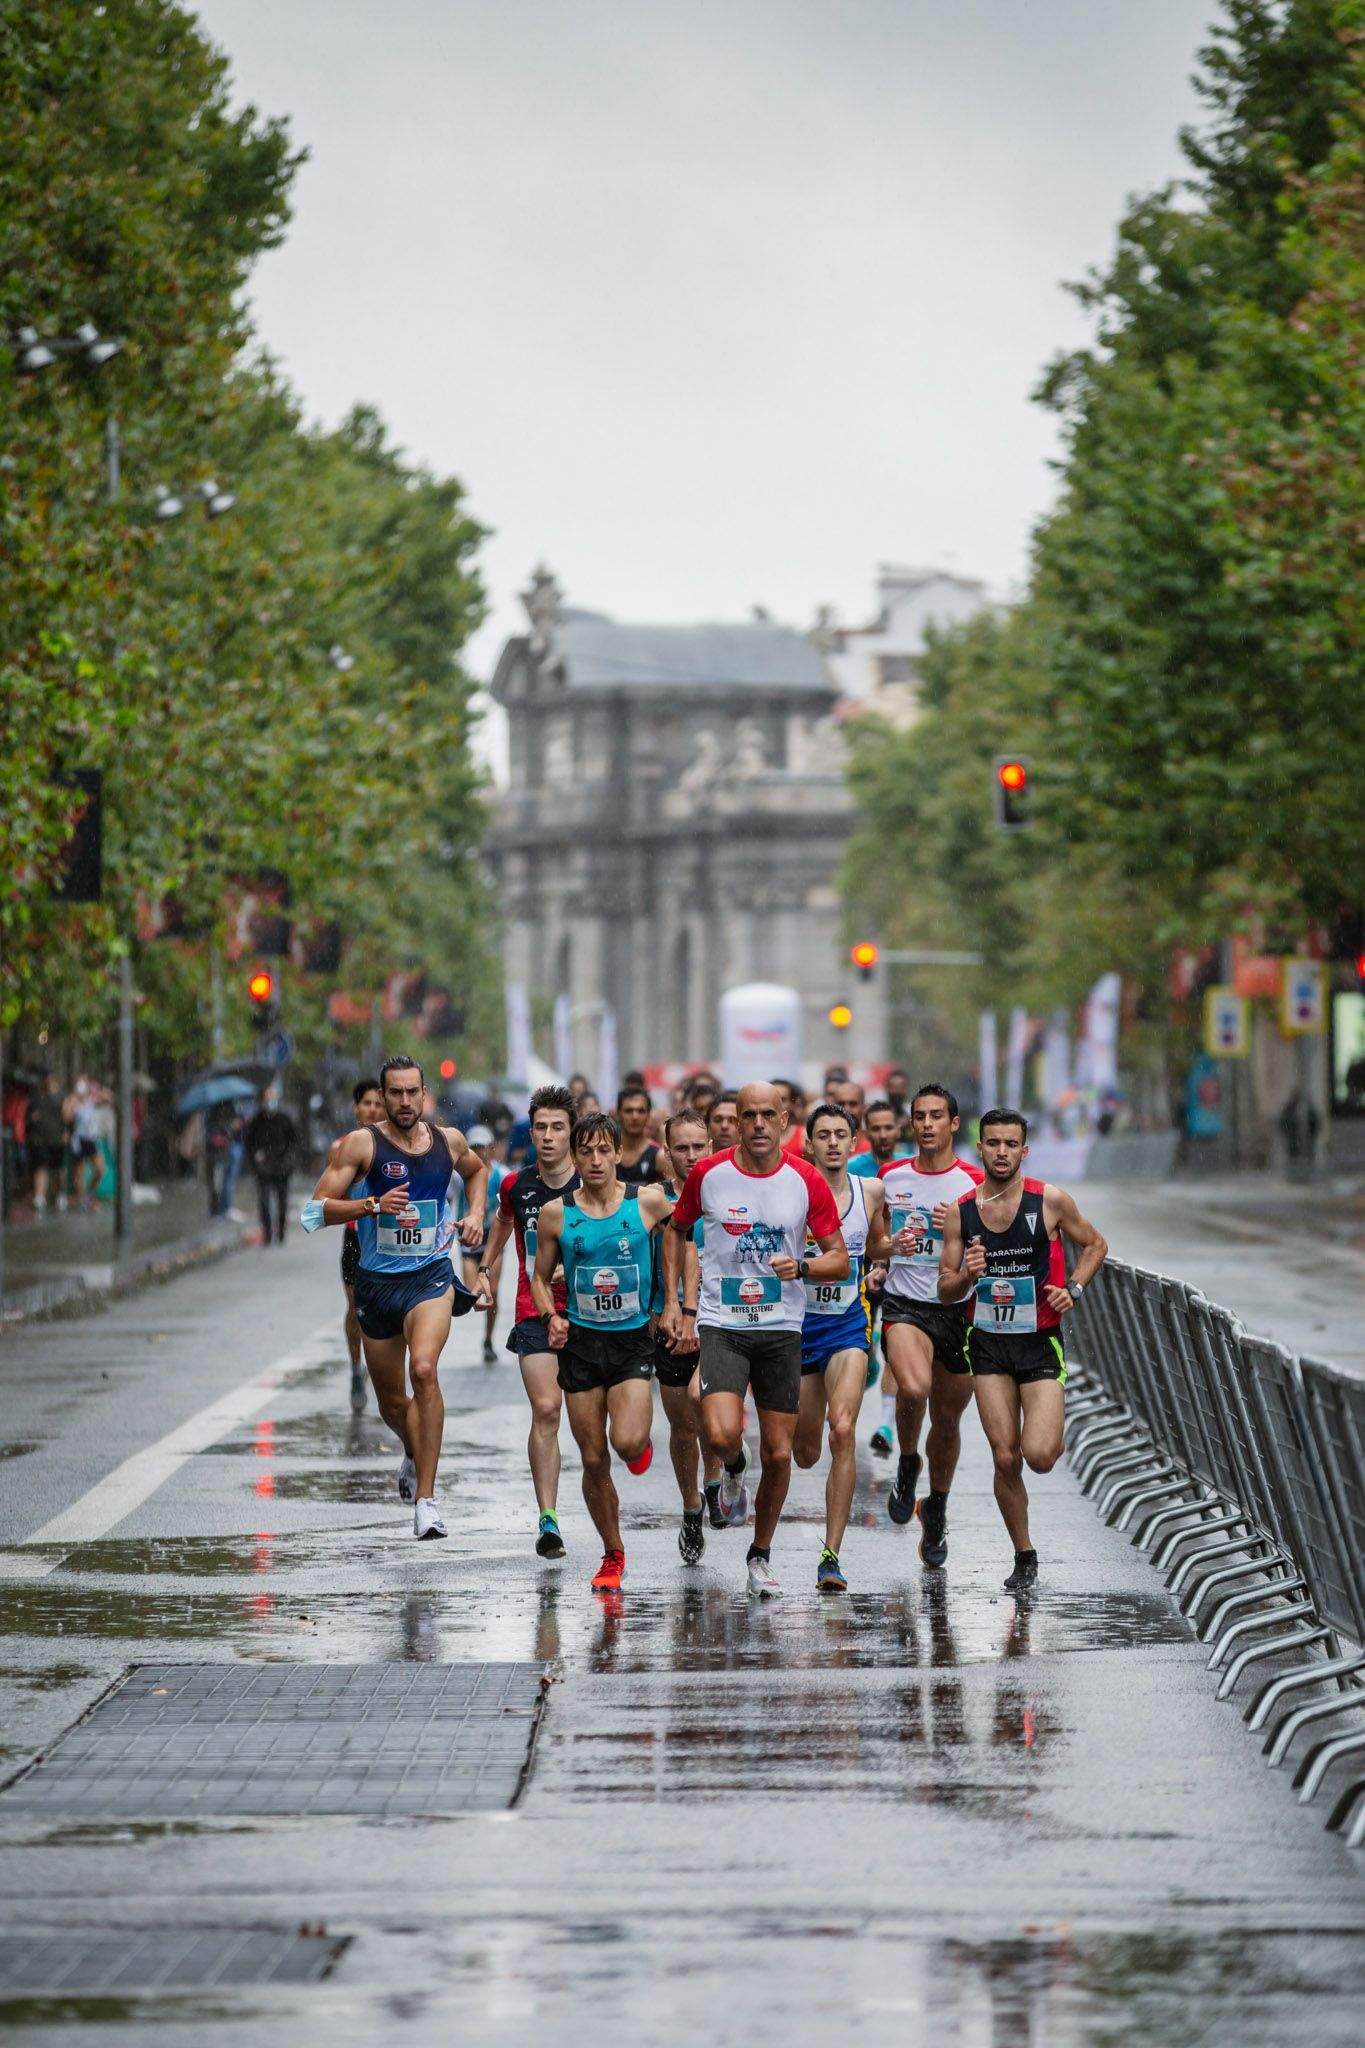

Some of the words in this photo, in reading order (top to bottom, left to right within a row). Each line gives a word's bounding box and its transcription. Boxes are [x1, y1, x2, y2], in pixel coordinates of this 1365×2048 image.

[525, 1206, 541, 1215] A.D.
[394, 1229, 422, 1245] 105
[914, 1238, 934, 1255] 54
[985, 1246, 1034, 1258] MARATHON
[989, 1260, 1032, 1276] alquiber
[593, 1294, 622, 1311] 150
[814, 1286, 842, 1303] 194
[731, 1306, 750, 1314] REYES
[751, 1304, 774, 1313] ESTEVEZ
[993, 1305, 1016, 1322] 177
[747, 1313, 760, 1323] 36
